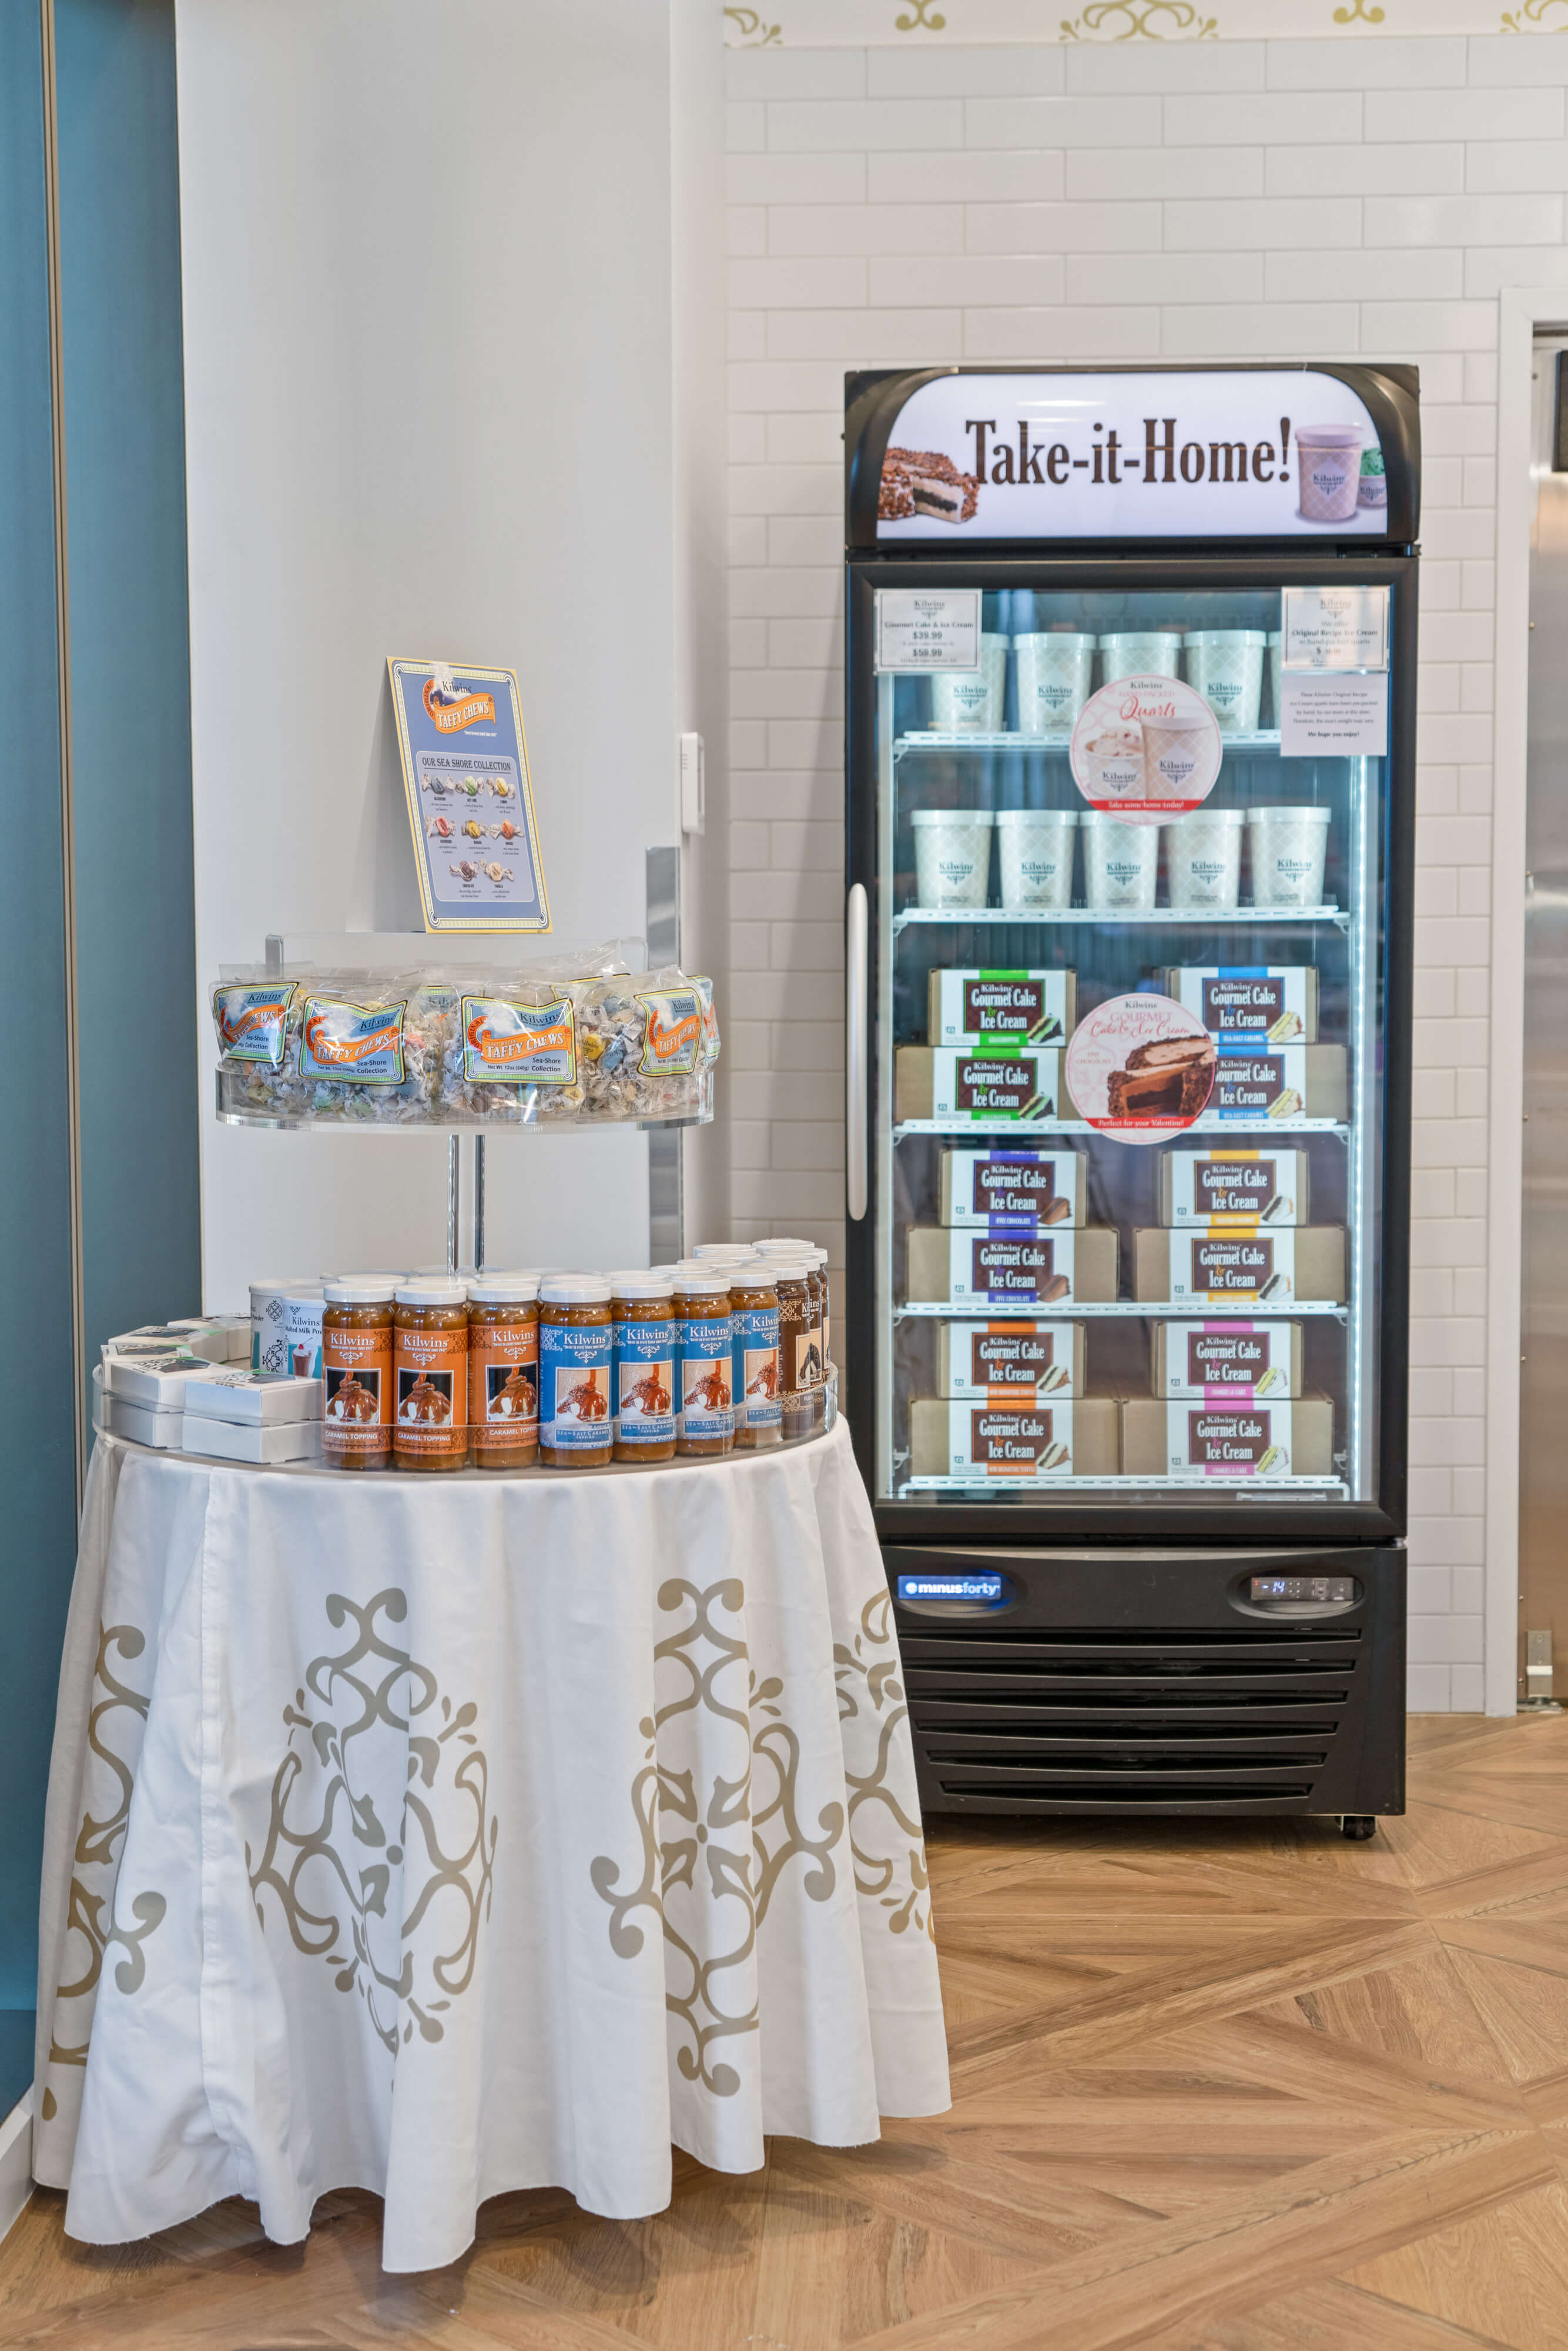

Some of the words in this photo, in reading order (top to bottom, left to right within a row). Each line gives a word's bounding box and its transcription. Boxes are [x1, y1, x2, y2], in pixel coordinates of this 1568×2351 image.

[966, 417, 1292, 485] Take-it-Home!
[913, 631, 943, 639] $39.99
[1292, 629, 1319, 638] Original
[913, 648, 943, 657] $59.99
[442, 681, 472, 694] Kilwins
[1038, 685, 1073, 694] Kilwins
[1208, 682, 1242, 691] Kilwins
[437, 711, 463, 728] TAFFY
[463, 701, 490, 721] CHEWS
[1120, 695, 1175, 721] Quarts
[423, 758, 436, 766] OUR
[437, 758, 451, 768] SEA
[452, 759, 473, 769] SHORE
[474, 761, 511, 771] COLLECTION
[1160, 760, 1194, 769] Kilwins
[1103, 771, 1137, 781] Kilwins
[1163, 801, 1184, 809] today!
[940, 862, 973, 870] Kilwins
[1021, 862, 1056, 870] Kilwins
[1107, 862, 1142, 871] Kilwins
[1191, 860, 1225, 870] Kilwins
[1278, 859, 1312, 868] Kilwins
[249, 992, 282, 1001] Kilwins
[971, 989, 1012, 1007] Gourmet
[1013, 988, 1037, 1007] Cake
[1211, 987, 1251, 1006] Gourmet
[1252, 987, 1276, 1005] Cake
[672, 1000, 694, 1010] Kilwins
[361, 1016, 394, 1029] Kilwins
[521, 1013, 560, 1024] Kilwins
[980, 1011, 996, 1029] Ice
[997, 1011, 1027, 1029] Cream
[1110, 1012, 1172, 1022] GOURMET
[1219, 1010, 1235, 1027] Ice
[1237, 1010, 1267, 1027] Cream
[469, 1018, 484, 1048] ORIGINAL
[1091, 1022, 1117, 1037] Cake
[1131, 1020, 1154, 1038] Ice
[1157, 1020, 1190, 1036] Cream
[485, 1041, 523, 1058] TAFFY
[526, 1033, 564, 1050] CHEWS
[658, 1035, 678, 1053] TAFFY
[678, 1023, 696, 1044] CHEWS
[317, 1046, 353, 1059] TAFFY
[355, 1034, 390, 1057] CHEWS
[963, 1067, 1004, 1085] Gourmet
[1005, 1067, 1029, 1085] Cake
[1252, 1064, 1276, 1082] Cake
[972, 1089, 987, 1107] Ice
[989, 1089, 1019, 1107] Cream
[1219, 1087, 1235, 1105] Ice
[1237, 1087, 1267, 1105] Cream
[981, 1170, 1022, 1188] Gourmet
[1023, 1170, 1046, 1188] Cake
[1202, 1170, 1242, 1187] Gourmet
[1244, 1170, 1267, 1187] Cake
[990, 1192, 1004, 1210] Ice
[1006, 1193, 1037, 1210] Cream
[1211, 1192, 1227, 1210] Ice
[1228, 1192, 1258, 1210] Cream
[980, 1248, 1021, 1265] Gourmet
[1022, 1248, 1046, 1266] Cake
[1200, 1248, 1239, 1265] Gourmet
[1241, 1248, 1265, 1265] Cake
[989, 1270, 1004, 1288] Ice
[1006, 1270, 1036, 1288] Cream
[1209, 1270, 1224, 1287] Ice
[1225, 1270, 1255, 1287] Cream
[292, 1317, 320, 1327] Kilwins
[331, 1334, 375, 1345] Kilwins
[494, 1330, 534, 1342] Kilwins
[564, 1334, 606, 1345] Kilwins
[627, 1329, 668, 1339] Kilwins
[690, 1326, 729, 1337] Kilwins
[404, 1335, 448, 1347] Kilwins
[980, 1342, 1020, 1359] Gourmet
[1021, 1342, 1044, 1359] Cake
[1197, 1342, 1237, 1359] Gourmet
[1238, 1342, 1261, 1359] Cake
[989, 1364, 1003, 1381] Ice
[1005, 1364, 1035, 1381] Cream
[1205, 1364, 1221, 1381] Ice
[1222, 1364, 1252, 1381] Cream
[326, 1431, 349, 1439] CARAMEL
[979, 1419, 1020, 1436] Gourmet
[1021, 1419, 1044, 1436] Cake
[1197, 1420, 1237, 1437] Gourmet
[1239, 1420, 1262, 1437] Cake
[398, 1433, 423, 1441] CARAMEL
[989, 1441, 1003, 1458] Ice
[1005, 1441, 1035, 1458] Cream
[1206, 1443, 1221, 1459] Ice
[1222, 1443, 1253, 1459] Cream
[918, 1582, 998, 1596] minusforty
